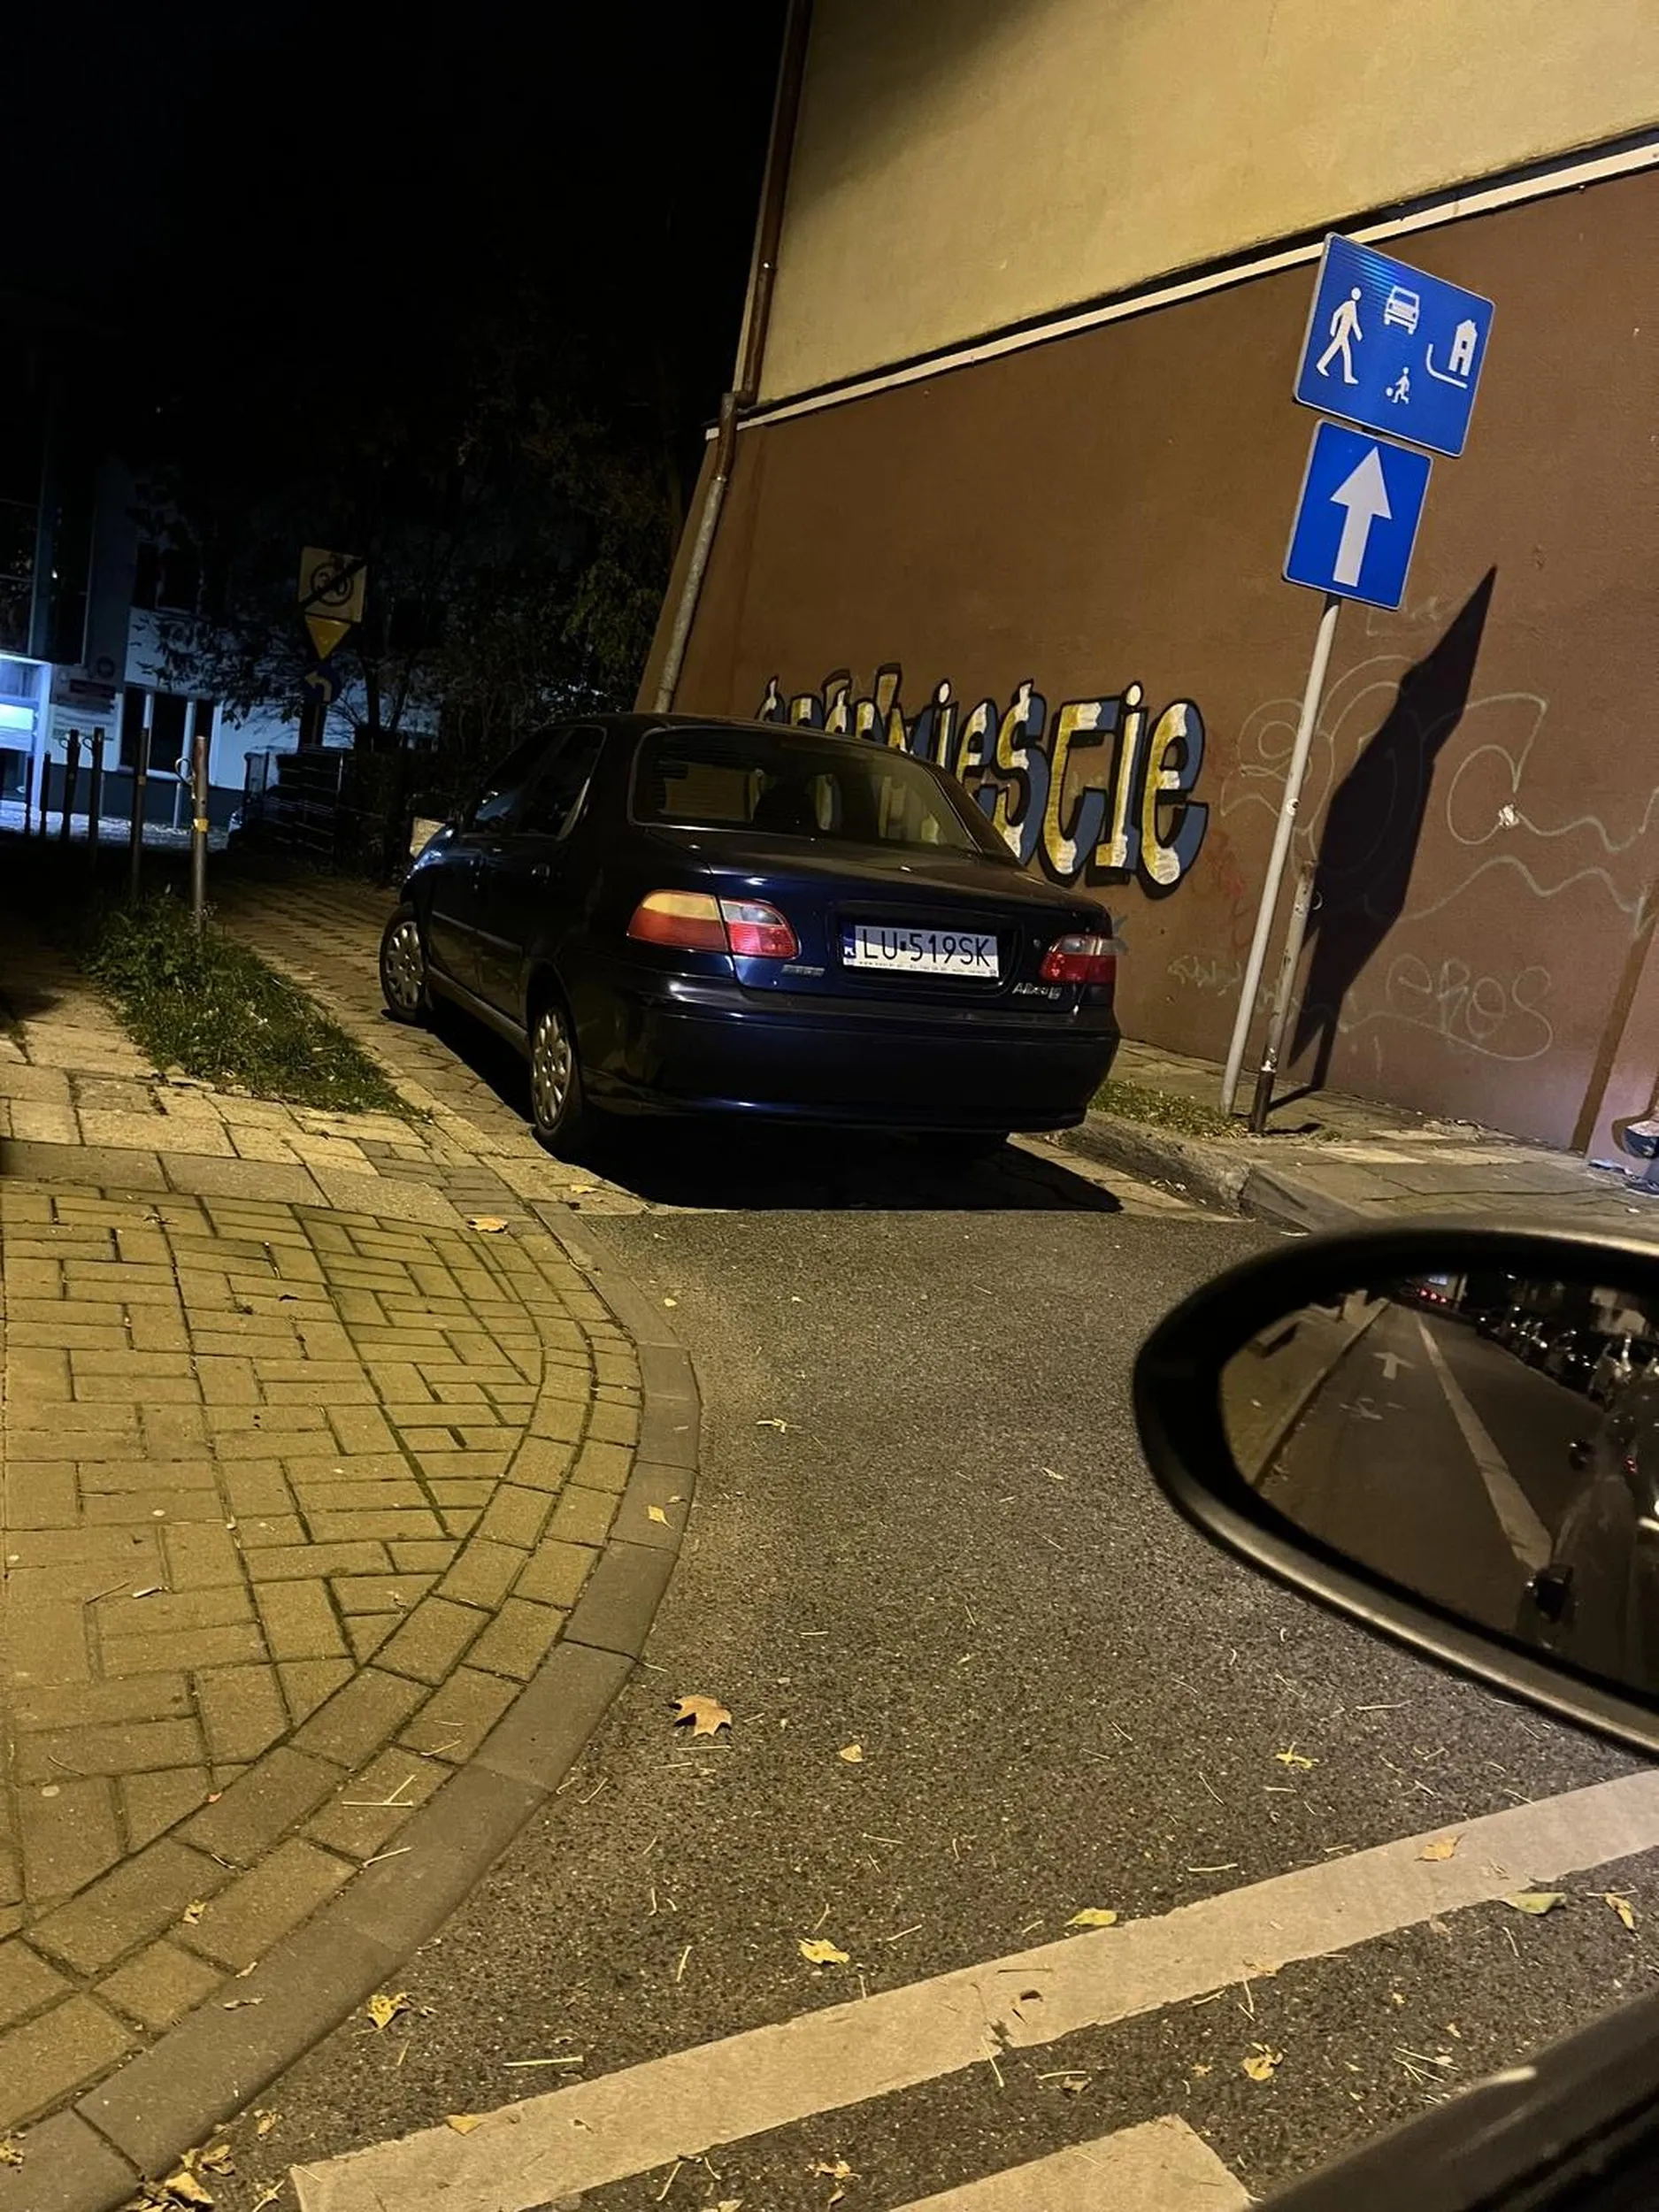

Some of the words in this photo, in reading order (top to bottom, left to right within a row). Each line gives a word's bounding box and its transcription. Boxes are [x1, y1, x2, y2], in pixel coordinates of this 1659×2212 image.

[755, 663, 1209, 899] ieście
[863, 929, 897, 960] LU
[909, 933, 991, 967] 519SK
